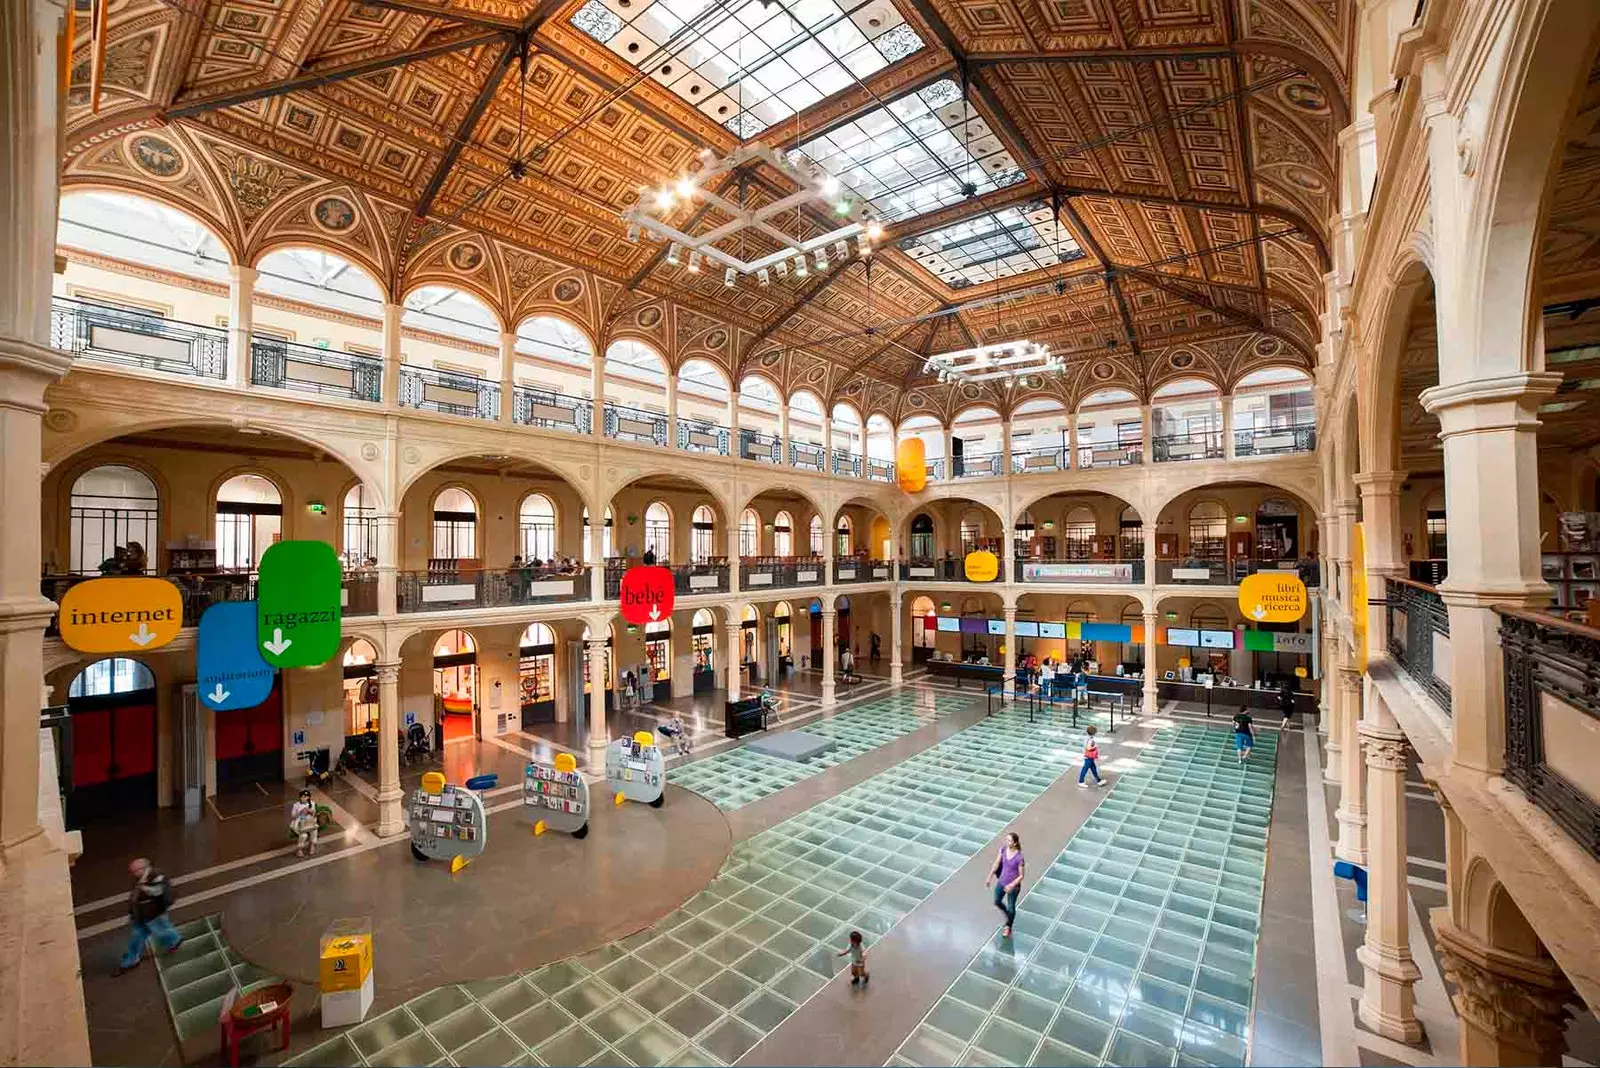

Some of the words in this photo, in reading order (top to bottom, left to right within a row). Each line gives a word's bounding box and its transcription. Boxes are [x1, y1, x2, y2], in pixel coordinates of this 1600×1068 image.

[1277, 583, 1300, 593] libri
[1262, 593, 1300, 602] musica
[1264, 602, 1300, 611] ricerca
[71, 608, 175, 625] internet
[264, 606, 336, 628] ragazzi
[1277, 635, 1306, 645] info
